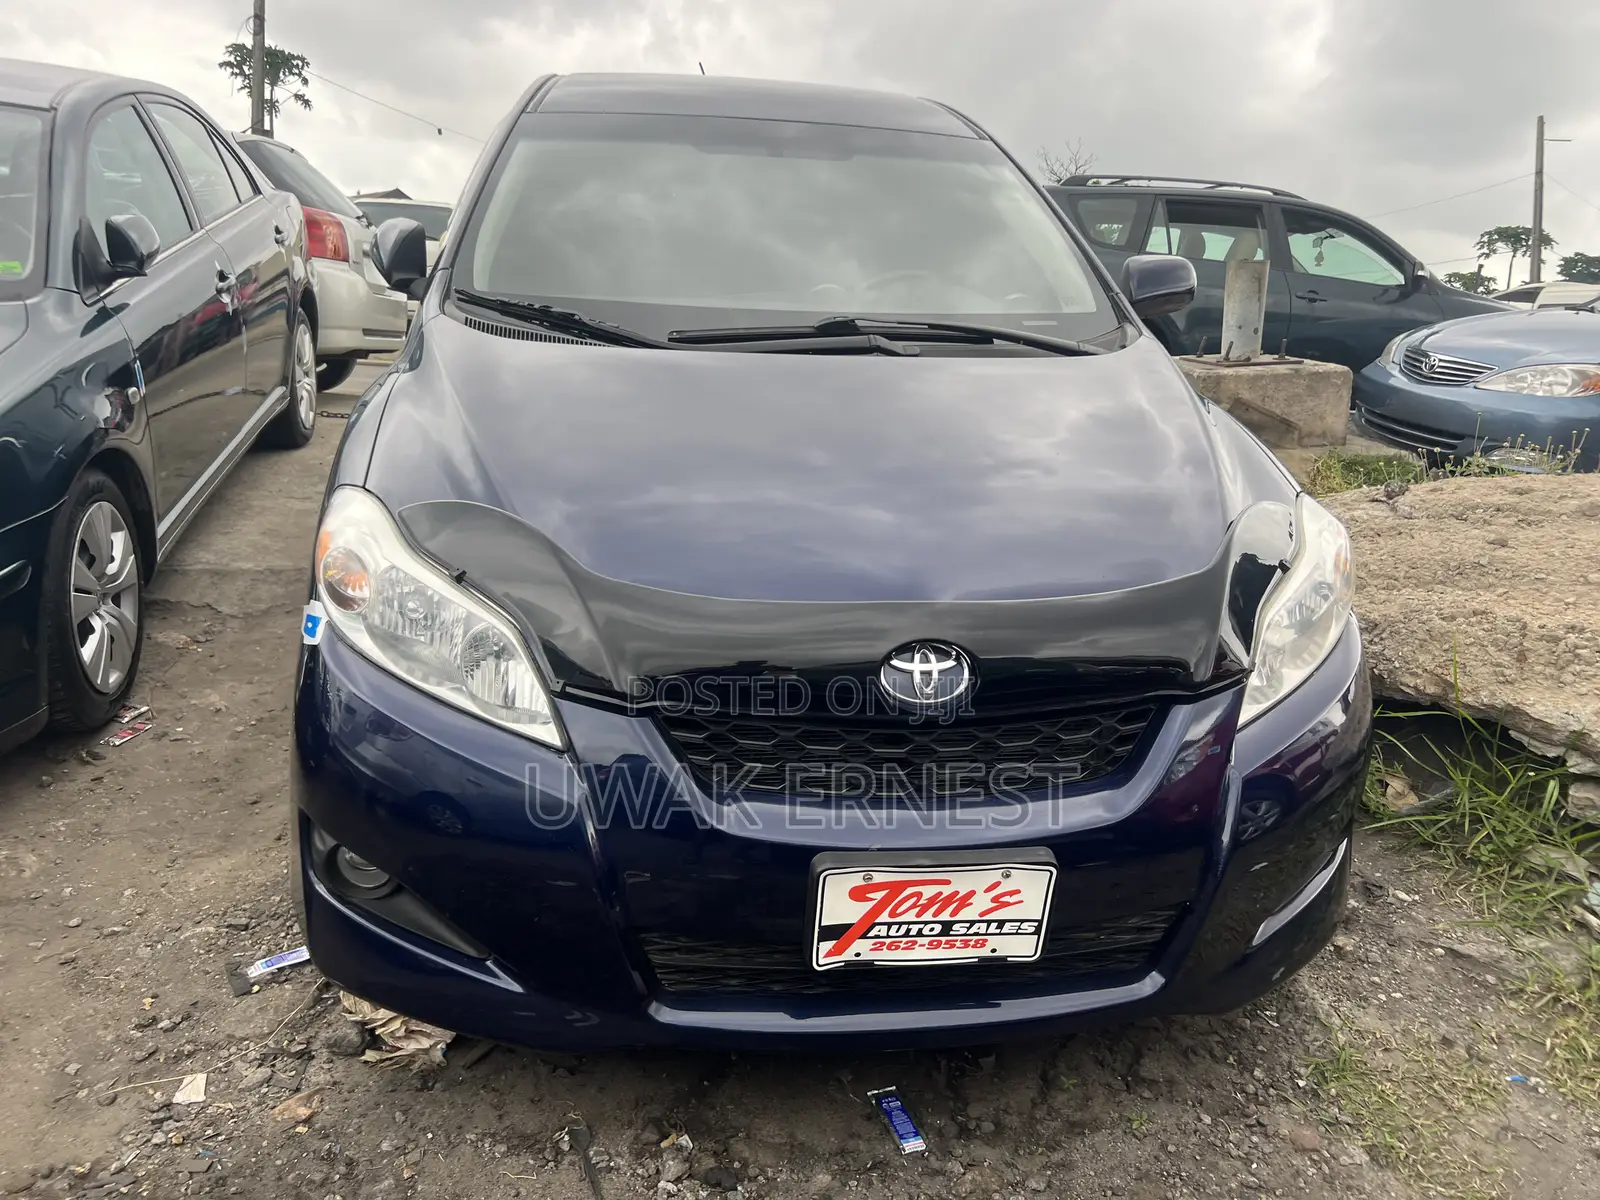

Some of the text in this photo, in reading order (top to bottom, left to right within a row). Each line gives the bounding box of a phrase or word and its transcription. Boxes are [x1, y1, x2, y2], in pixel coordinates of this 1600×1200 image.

[822, 878, 1024, 959] Tom's
[866, 921, 1039, 938] AUTO SALES
[868, 938, 989, 952] 262-9538
